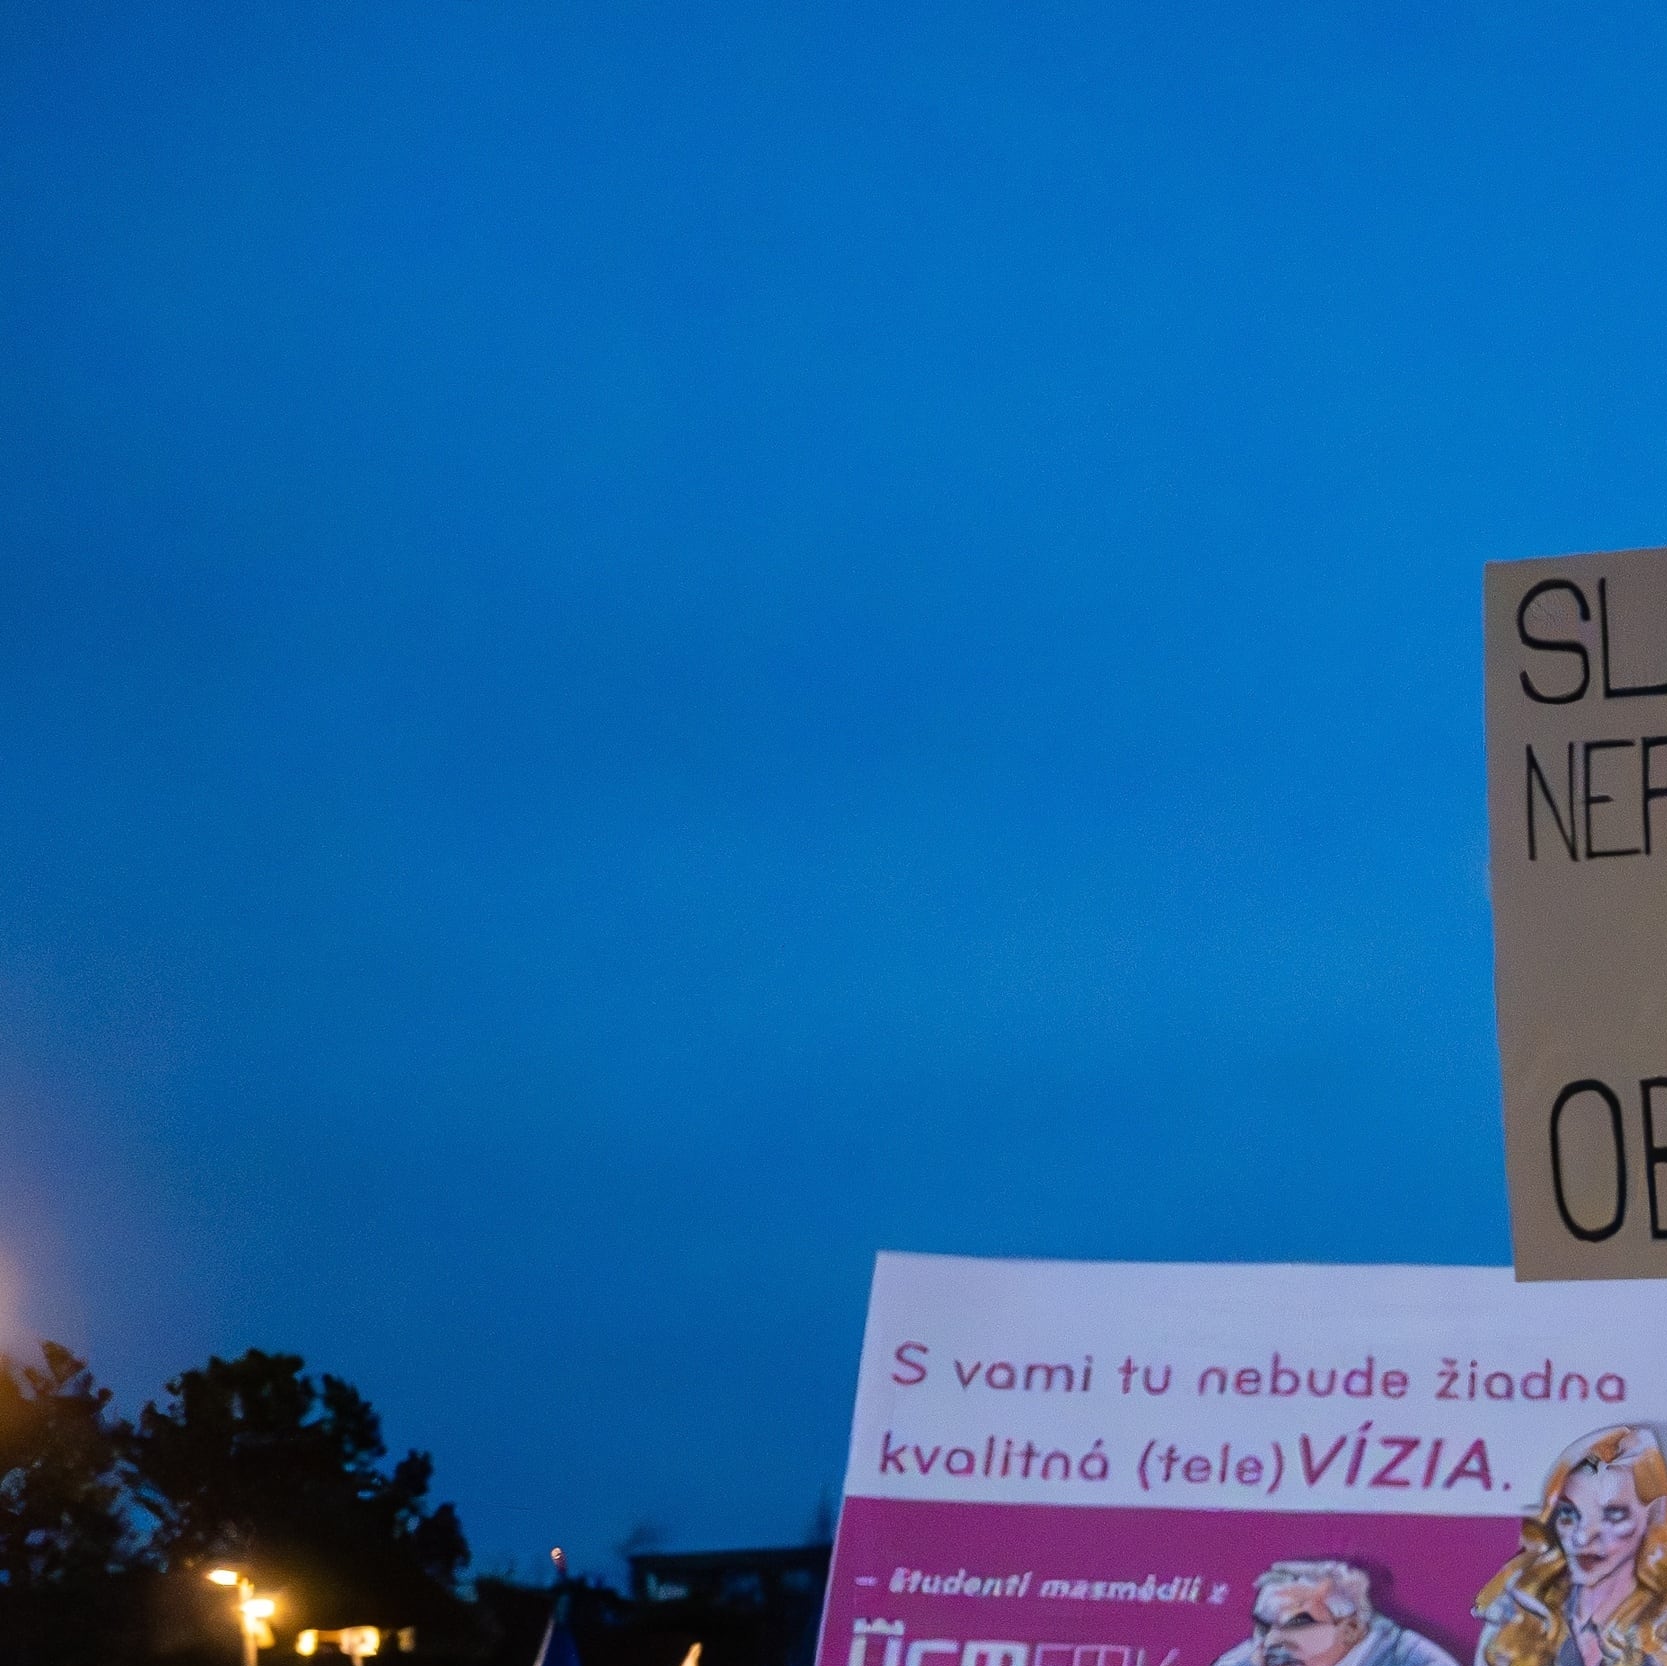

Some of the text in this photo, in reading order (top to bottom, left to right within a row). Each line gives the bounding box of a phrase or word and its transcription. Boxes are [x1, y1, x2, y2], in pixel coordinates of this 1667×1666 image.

[891, 1341, 1627, 1404] S vami tu nebude žiadna
[880, 1431, 1109, 1484] kvalitná
